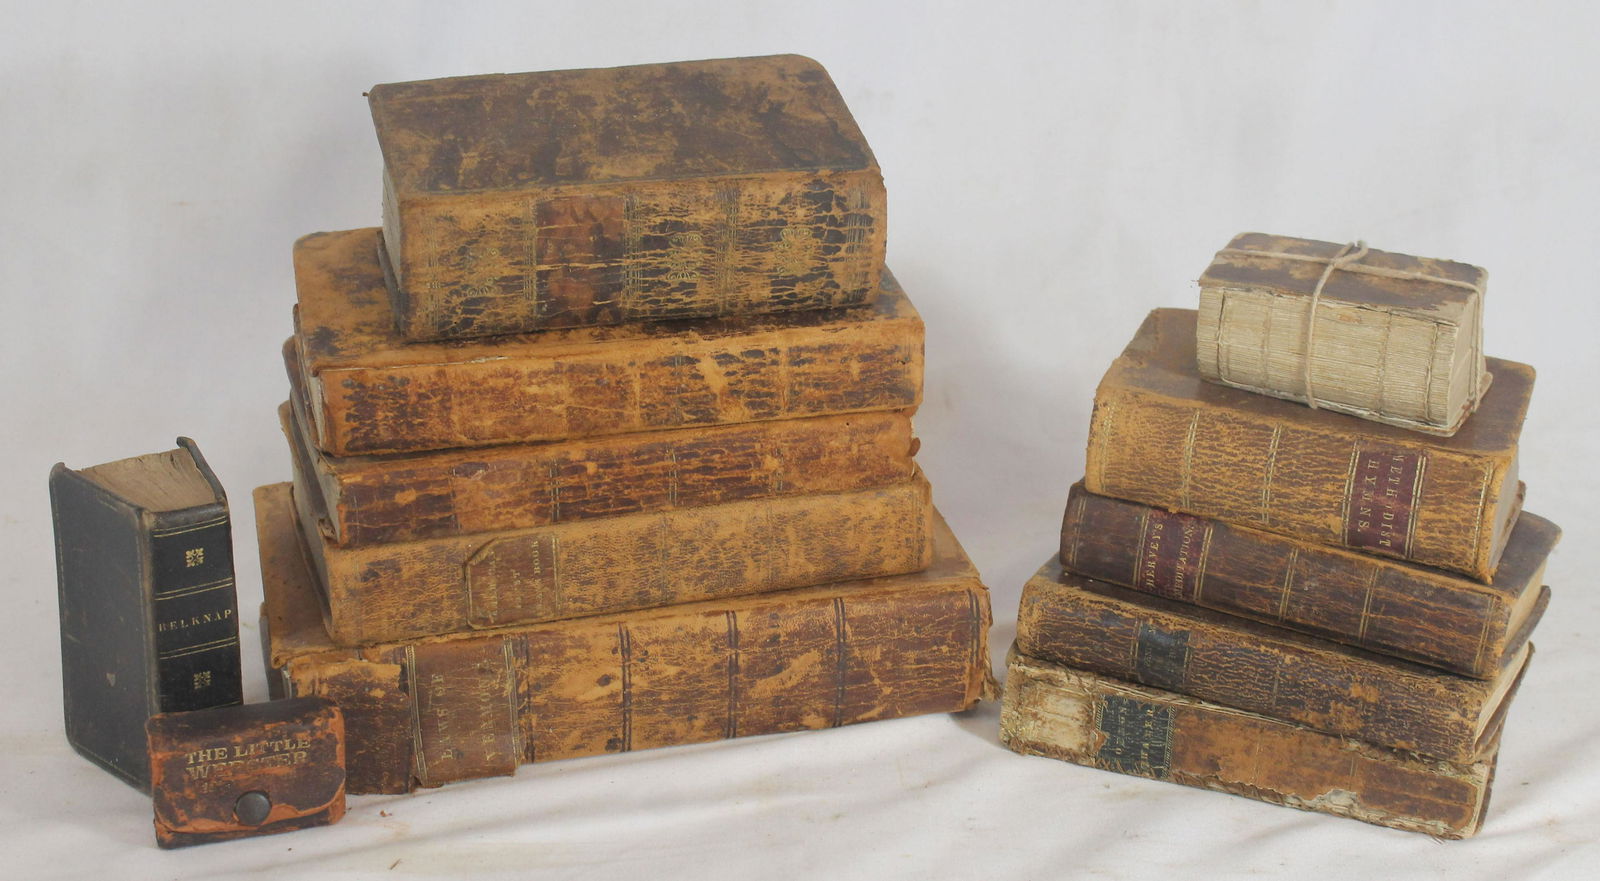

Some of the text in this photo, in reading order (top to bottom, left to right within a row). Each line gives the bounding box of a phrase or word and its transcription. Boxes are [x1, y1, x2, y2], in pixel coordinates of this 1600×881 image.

[158, 608, 233, 632] BELKNAP
[184, 738, 312, 765] THE LITTLE
